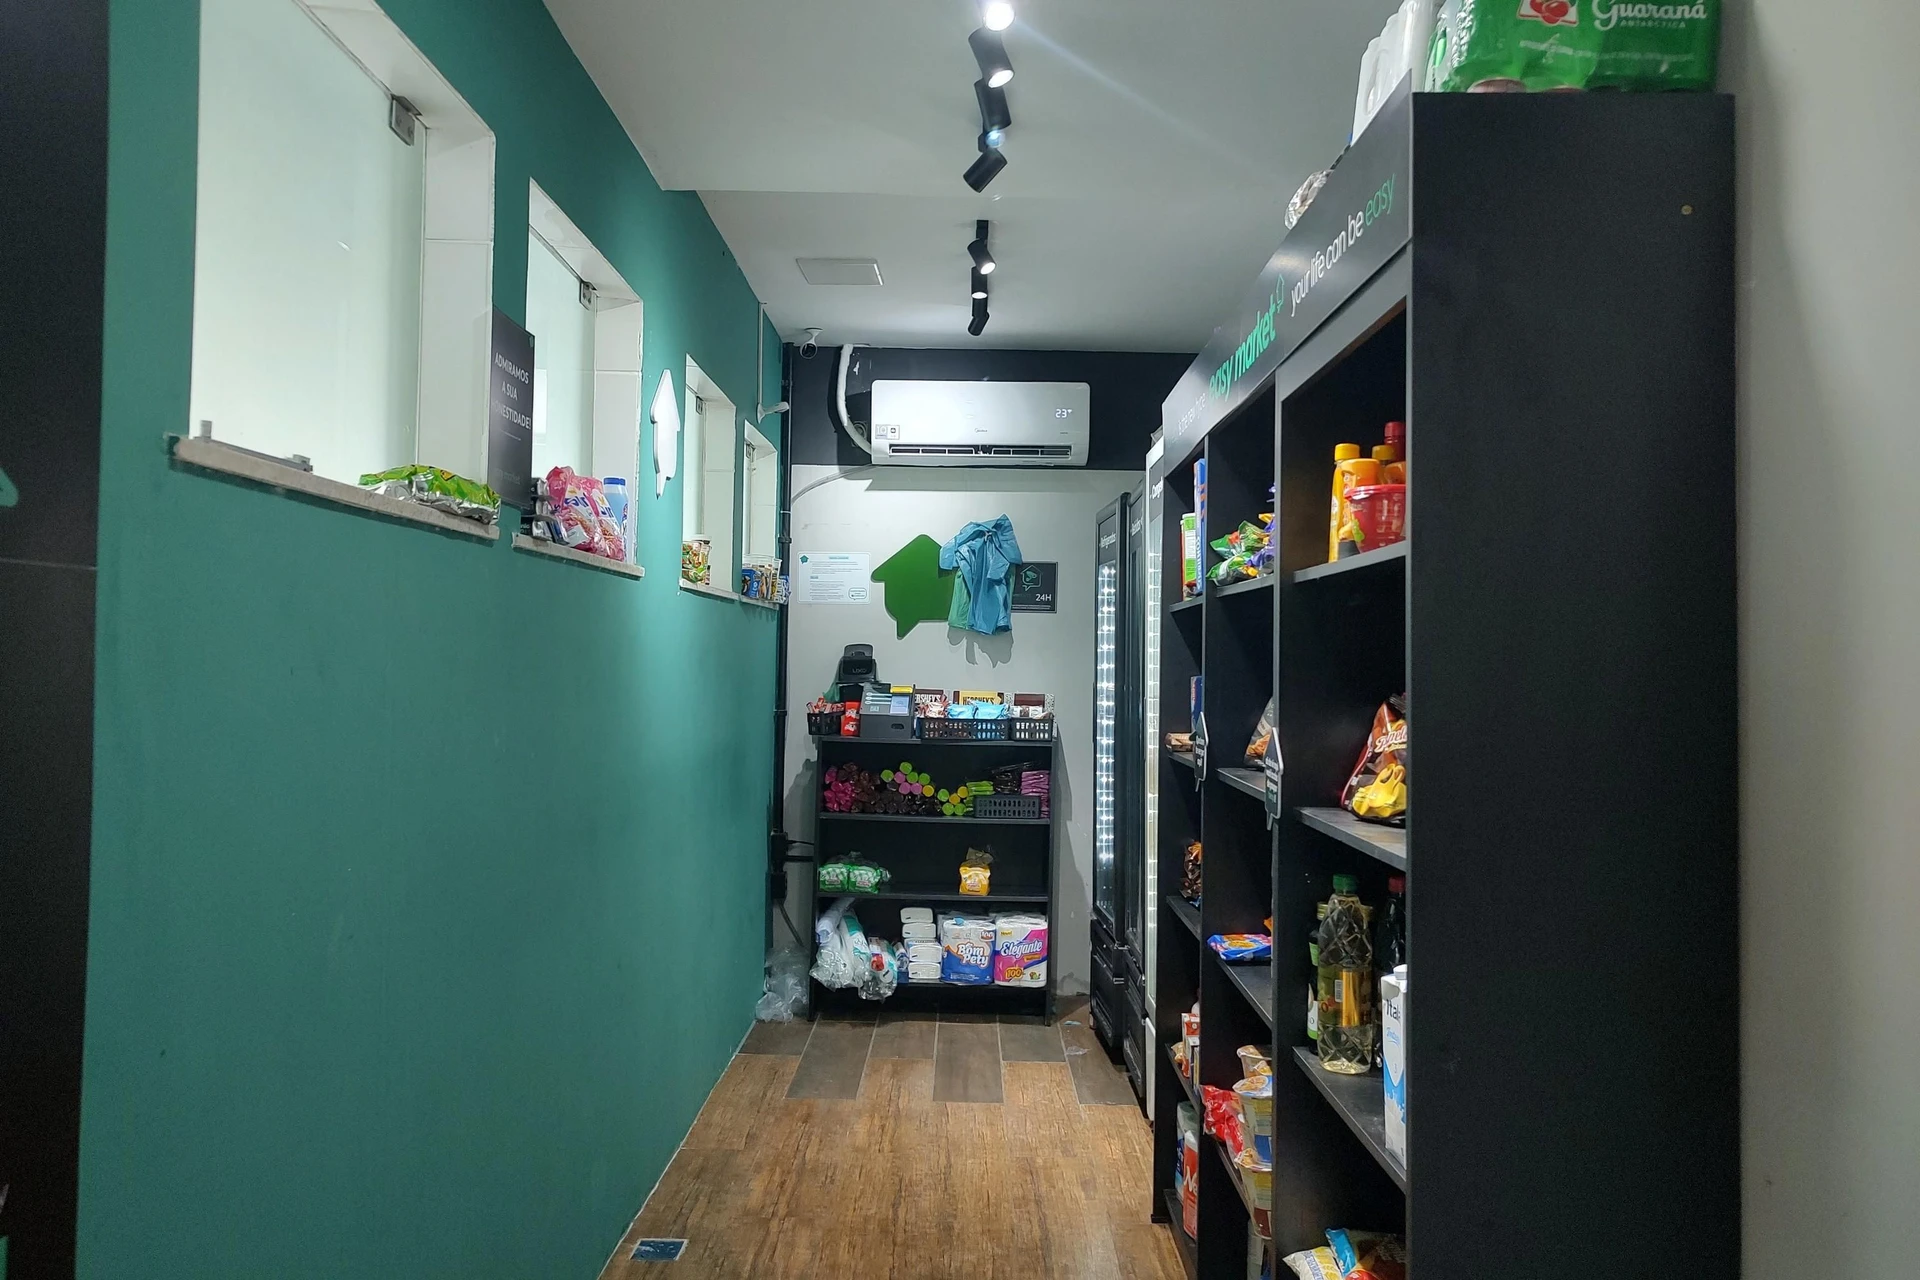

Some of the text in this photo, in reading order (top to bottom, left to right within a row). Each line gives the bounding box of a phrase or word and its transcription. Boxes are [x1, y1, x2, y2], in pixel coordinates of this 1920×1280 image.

[1592, 0, 1708, 31] Guaraná
[1290, 173, 1396, 317] your life can be easy
[1208, 293, 1276, 402] easy market
[494, 352, 530, 385] ADMIRAMOS
[506, 384, 518, 401] SUA
[1055, 408, 1068, 418] 23
[1035, 593, 1052, 602] 24H
[1000, 940, 1043, 959] Elegante
[962, 954, 989, 968] Pety
[1006, 968, 1022, 978] 100
